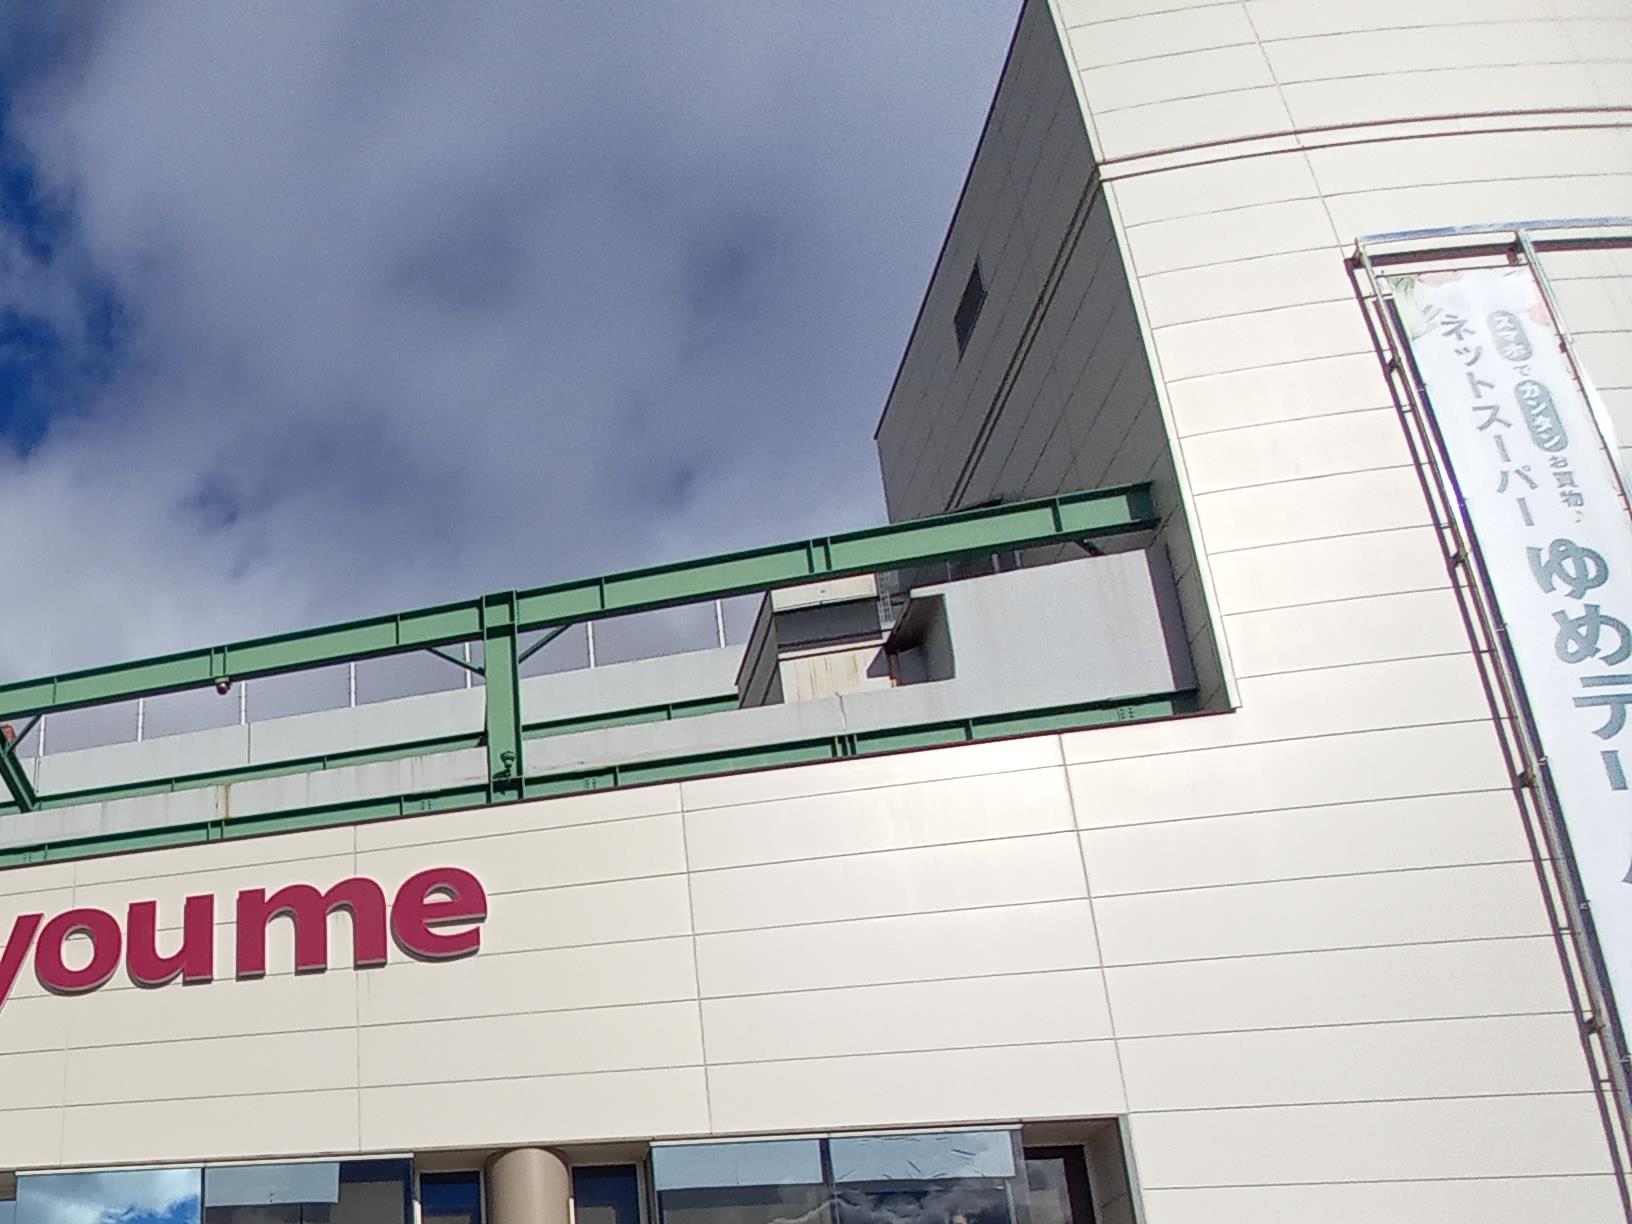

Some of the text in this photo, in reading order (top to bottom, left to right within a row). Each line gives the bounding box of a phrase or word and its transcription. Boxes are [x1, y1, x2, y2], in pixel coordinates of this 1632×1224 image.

[1441, 313, 1538, 527] ネットスーパー
